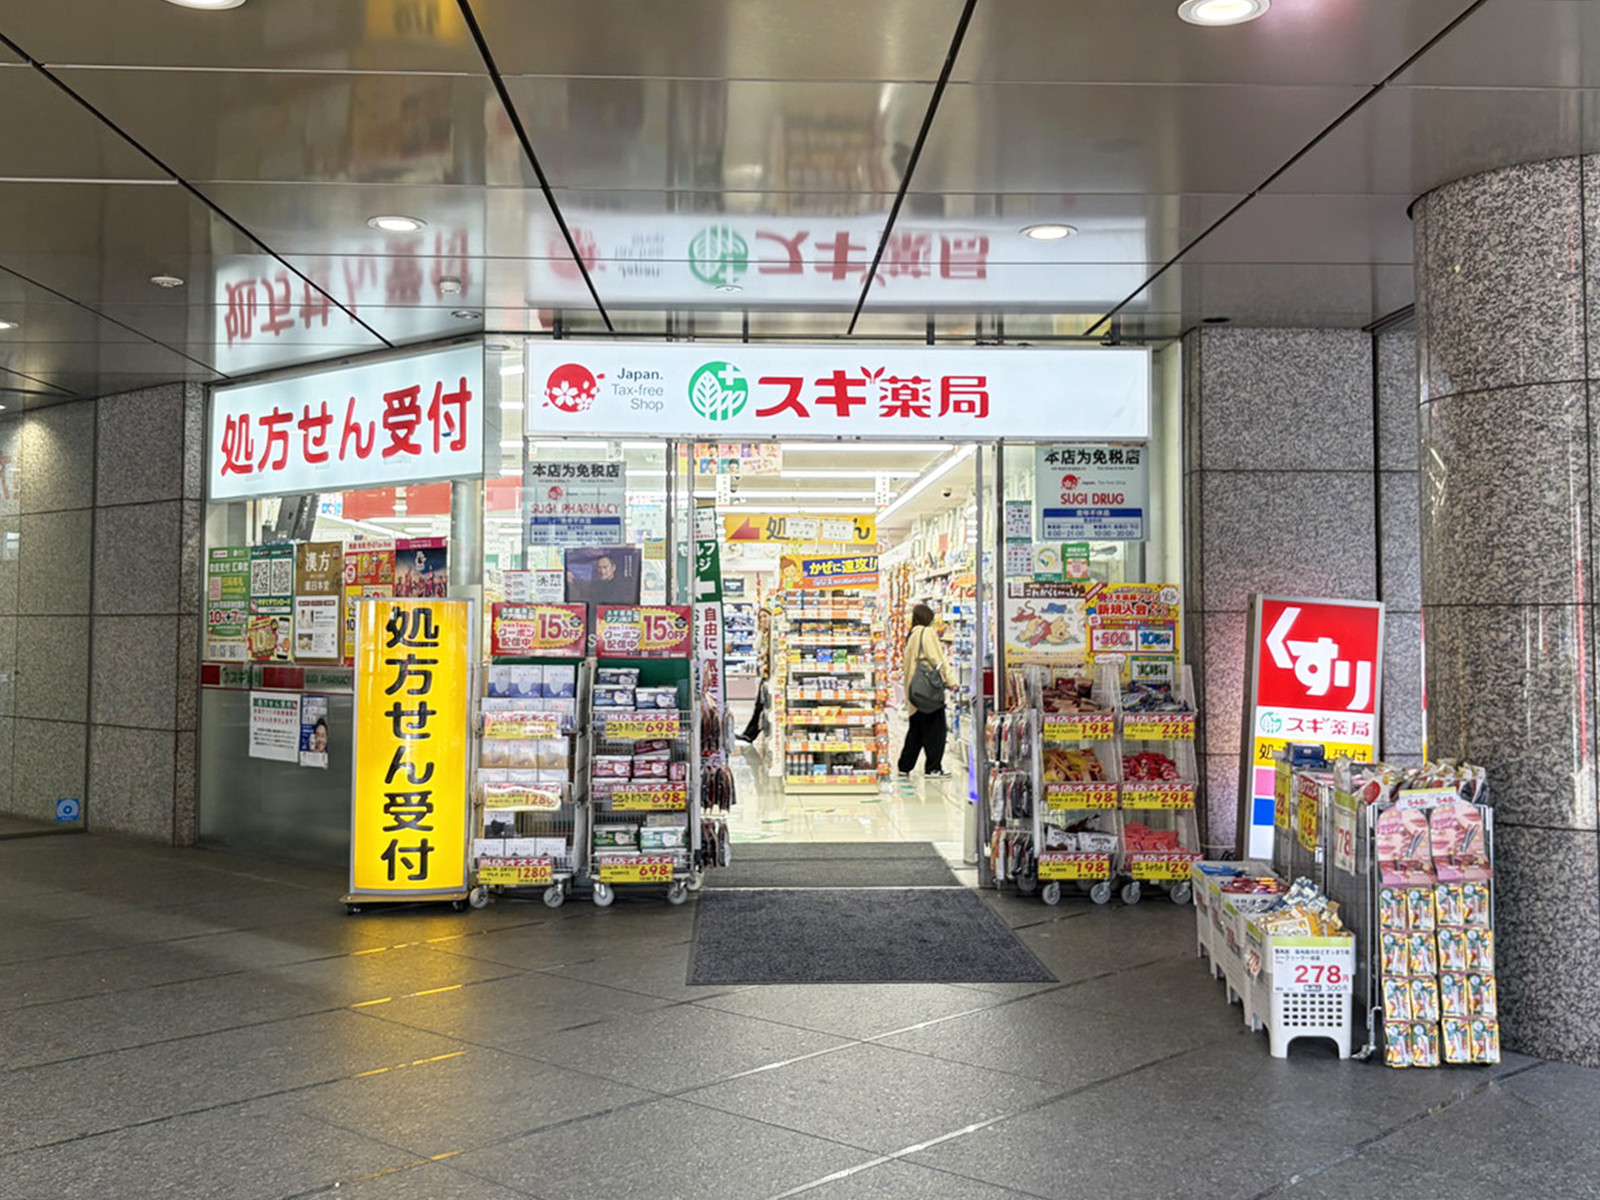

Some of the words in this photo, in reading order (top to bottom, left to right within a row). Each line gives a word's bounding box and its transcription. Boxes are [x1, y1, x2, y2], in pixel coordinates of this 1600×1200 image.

[617, 367, 664, 381] Japan.
[611, 383, 664, 397] Tax-free
[755, 367, 989, 418] スギ薬局
[630, 398, 664, 413] Shop
[221, 376, 473, 476] 処方せん受付
[1044, 449, 1140, 465] 本店为免税店
[532, 463, 620, 478] 本店为免税店
[1060, 493, 1088, 505] SUGI
[1092, 493, 1125, 505] DRUG
[531, 503, 557, 515] SUGI
[561, 503, 620, 515] PHARMACY
[305, 551, 331, 572] 漢方
[498, 629, 535, 639] クーポン
[562, 629, 581, 639] OFF
[603, 631, 641, 641] クーポン
[667, 631, 687, 642] OFF
[500, 639, 532, 648] 配信中
[606, 640, 638, 650] 配信中
[1266, 607, 1371, 710] くすり
[645, 722, 675, 733] 698
[1082, 723, 1109, 734] 198
[1162, 723, 1189, 734] 228
[1286, 716, 1370, 737] スギ薬局
[380, 606, 439, 881] 処方せん受付
[652, 793, 679, 804] 698
[1086, 792, 1113, 803] 198
[1161, 792, 1189, 803] 298
[517, 867, 547, 878] 1280
[640, 865, 668, 876] 698
[1076, 862, 1104, 873] 198
[1171, 862, 1189, 873] 29
